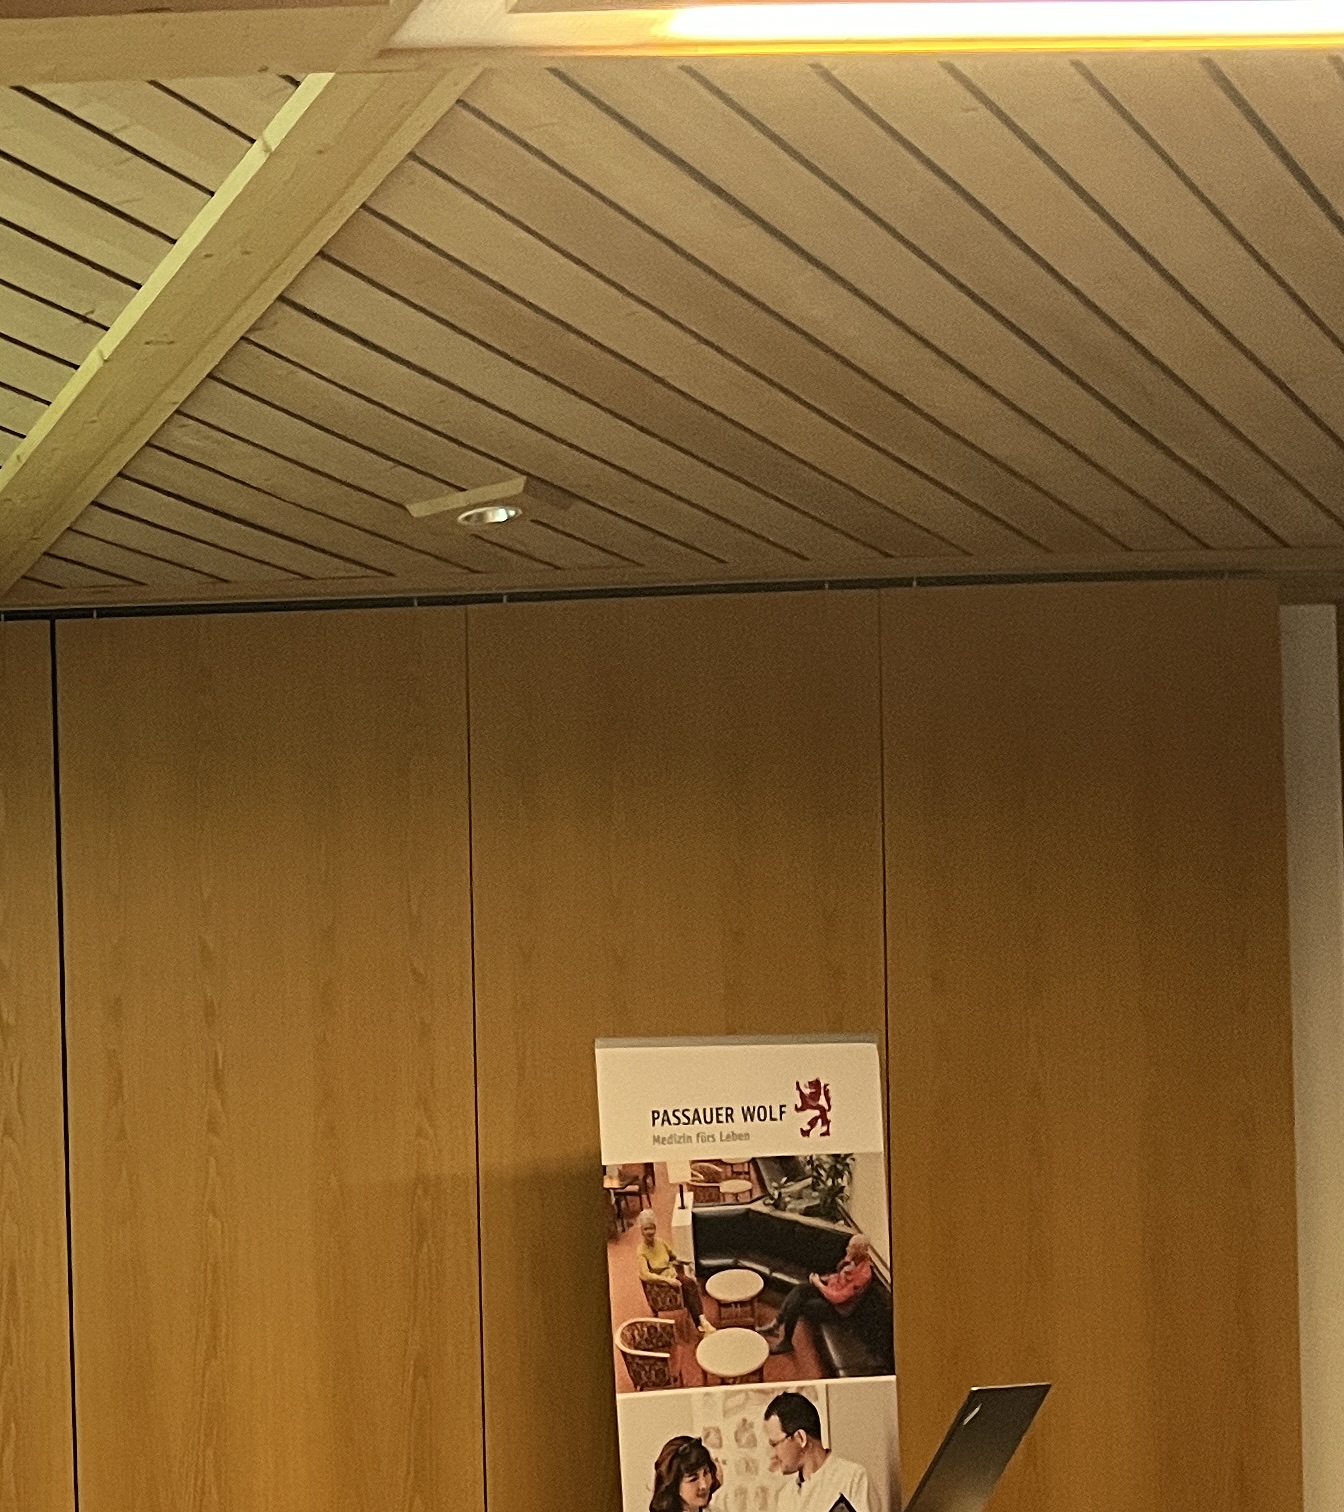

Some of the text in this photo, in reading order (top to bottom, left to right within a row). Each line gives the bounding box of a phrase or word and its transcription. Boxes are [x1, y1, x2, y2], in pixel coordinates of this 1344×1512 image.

[650, 1103, 787, 1127] PASSAUER WOLF
[652, 1131, 693, 1146] Medizin
[719, 1130, 751, 1143] Leben
